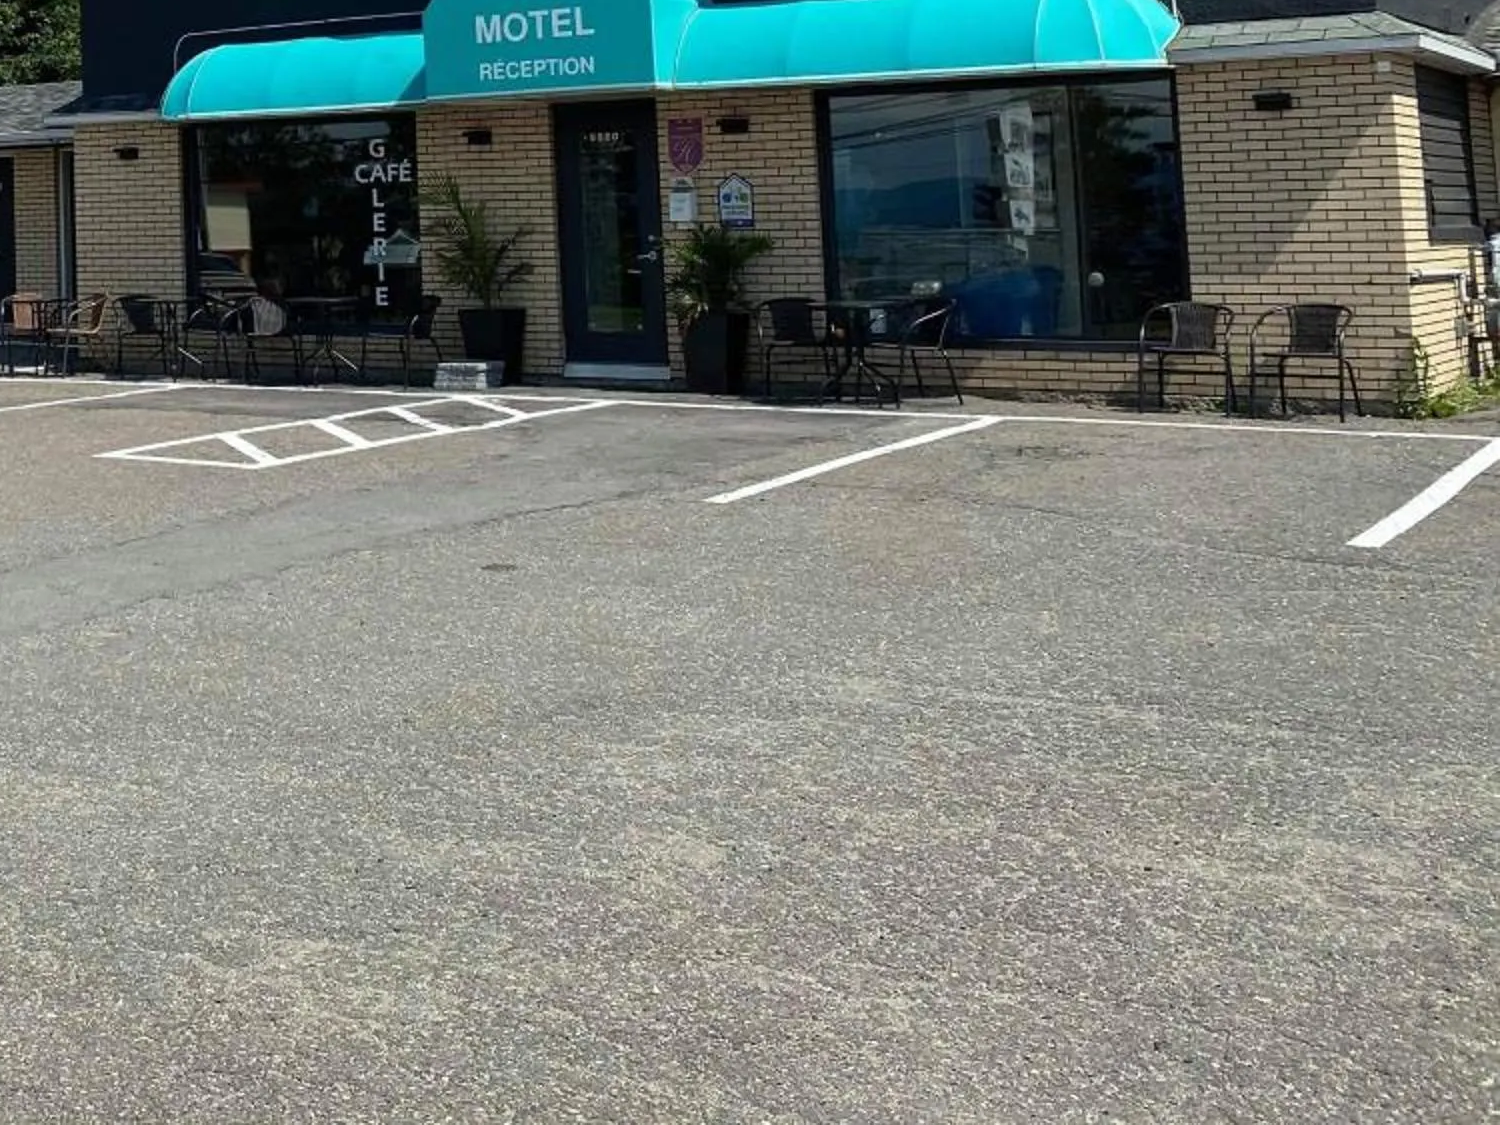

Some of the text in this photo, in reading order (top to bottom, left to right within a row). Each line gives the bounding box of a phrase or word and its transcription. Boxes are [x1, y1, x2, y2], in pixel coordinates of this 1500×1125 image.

[475, 7, 595, 43] MOTEL
[479, 56, 595, 81] RÉCEPTION
[355, 159, 412, 184] CAFÉ
